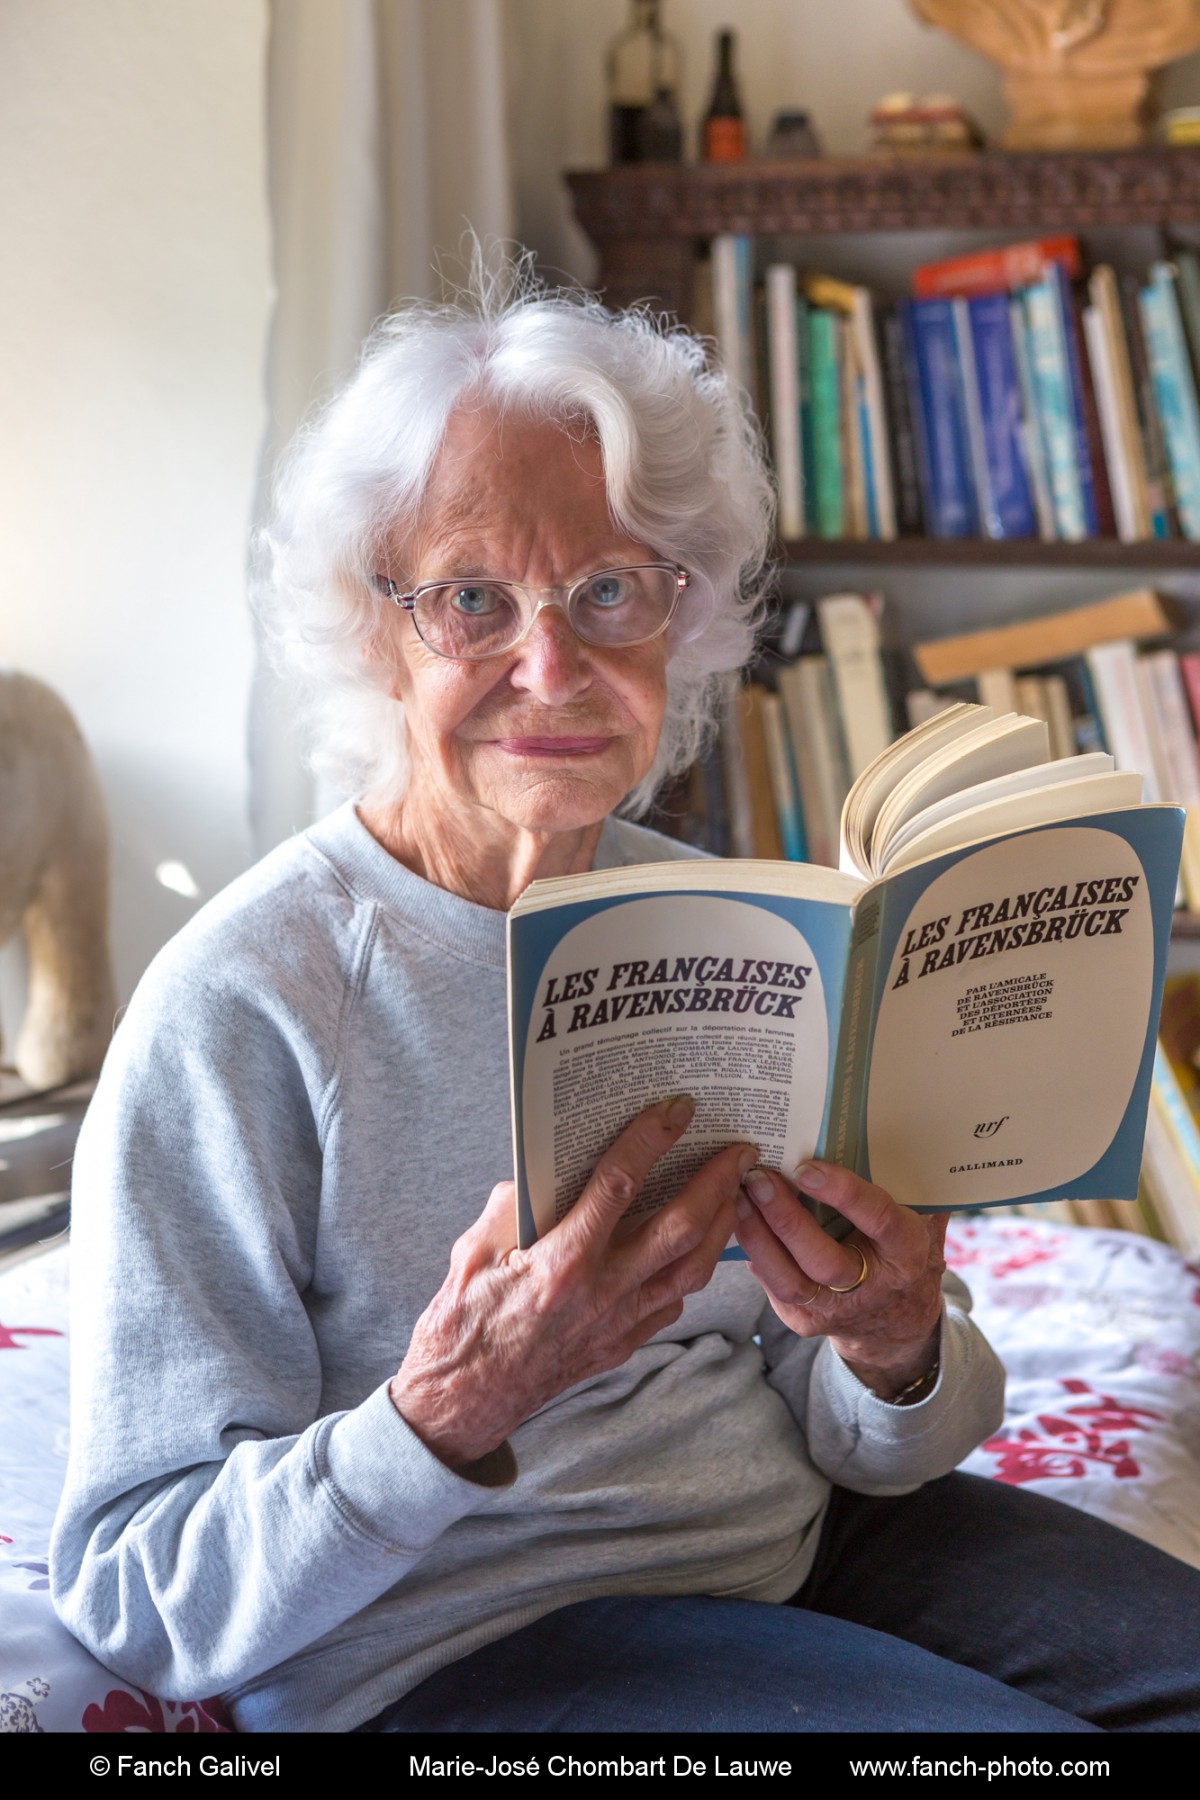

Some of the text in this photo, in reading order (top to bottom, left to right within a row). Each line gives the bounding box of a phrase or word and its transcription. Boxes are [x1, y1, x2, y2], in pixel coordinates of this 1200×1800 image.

[901, 915, 951, 957] LES
[955, 876, 1139, 936] FRANÇAISES
[892, 957, 909, 990] À
[918, 908, 1129, 978] RAVENSBRÜCK
[543, 955, 812, 1007] LES FRANÇAISES
[956, 979, 1054, 1006] DE RAVENSBRÜCK
[966, 973, 1047, 996] PAR L'AMICALE
[956, 987, 1053, 1014] ET L'ASSOCIATION
[959, 995, 1048, 1020] DES DÉPORTÉES
[535, 985, 802, 1043] À RAVENSBRÜCK
[951, 1010, 1054, 1038] DE LA RÉSISTANCE
[962, 1003, 1043, 1027] ET INTERNÉES
[573, 1041, 594, 1054] grand
[597, 1032, 639, 1046] témoignage
[642, 1026, 672, 1037] collectif
[702, 1025, 746, 1033] déportation
[765, 1027, 794, 1037] femmes
[597, 1041, 634, 1055] exceptionnel
[656, 1035, 693, 1043] témoignage
[596, 1050, 626, 1061] signatures
[682, 1067, 718, 1075] Jacqueline
[973, 1116, 1010, 1139] nrf
[949, 1158, 1023, 1174] GALLIMARD
